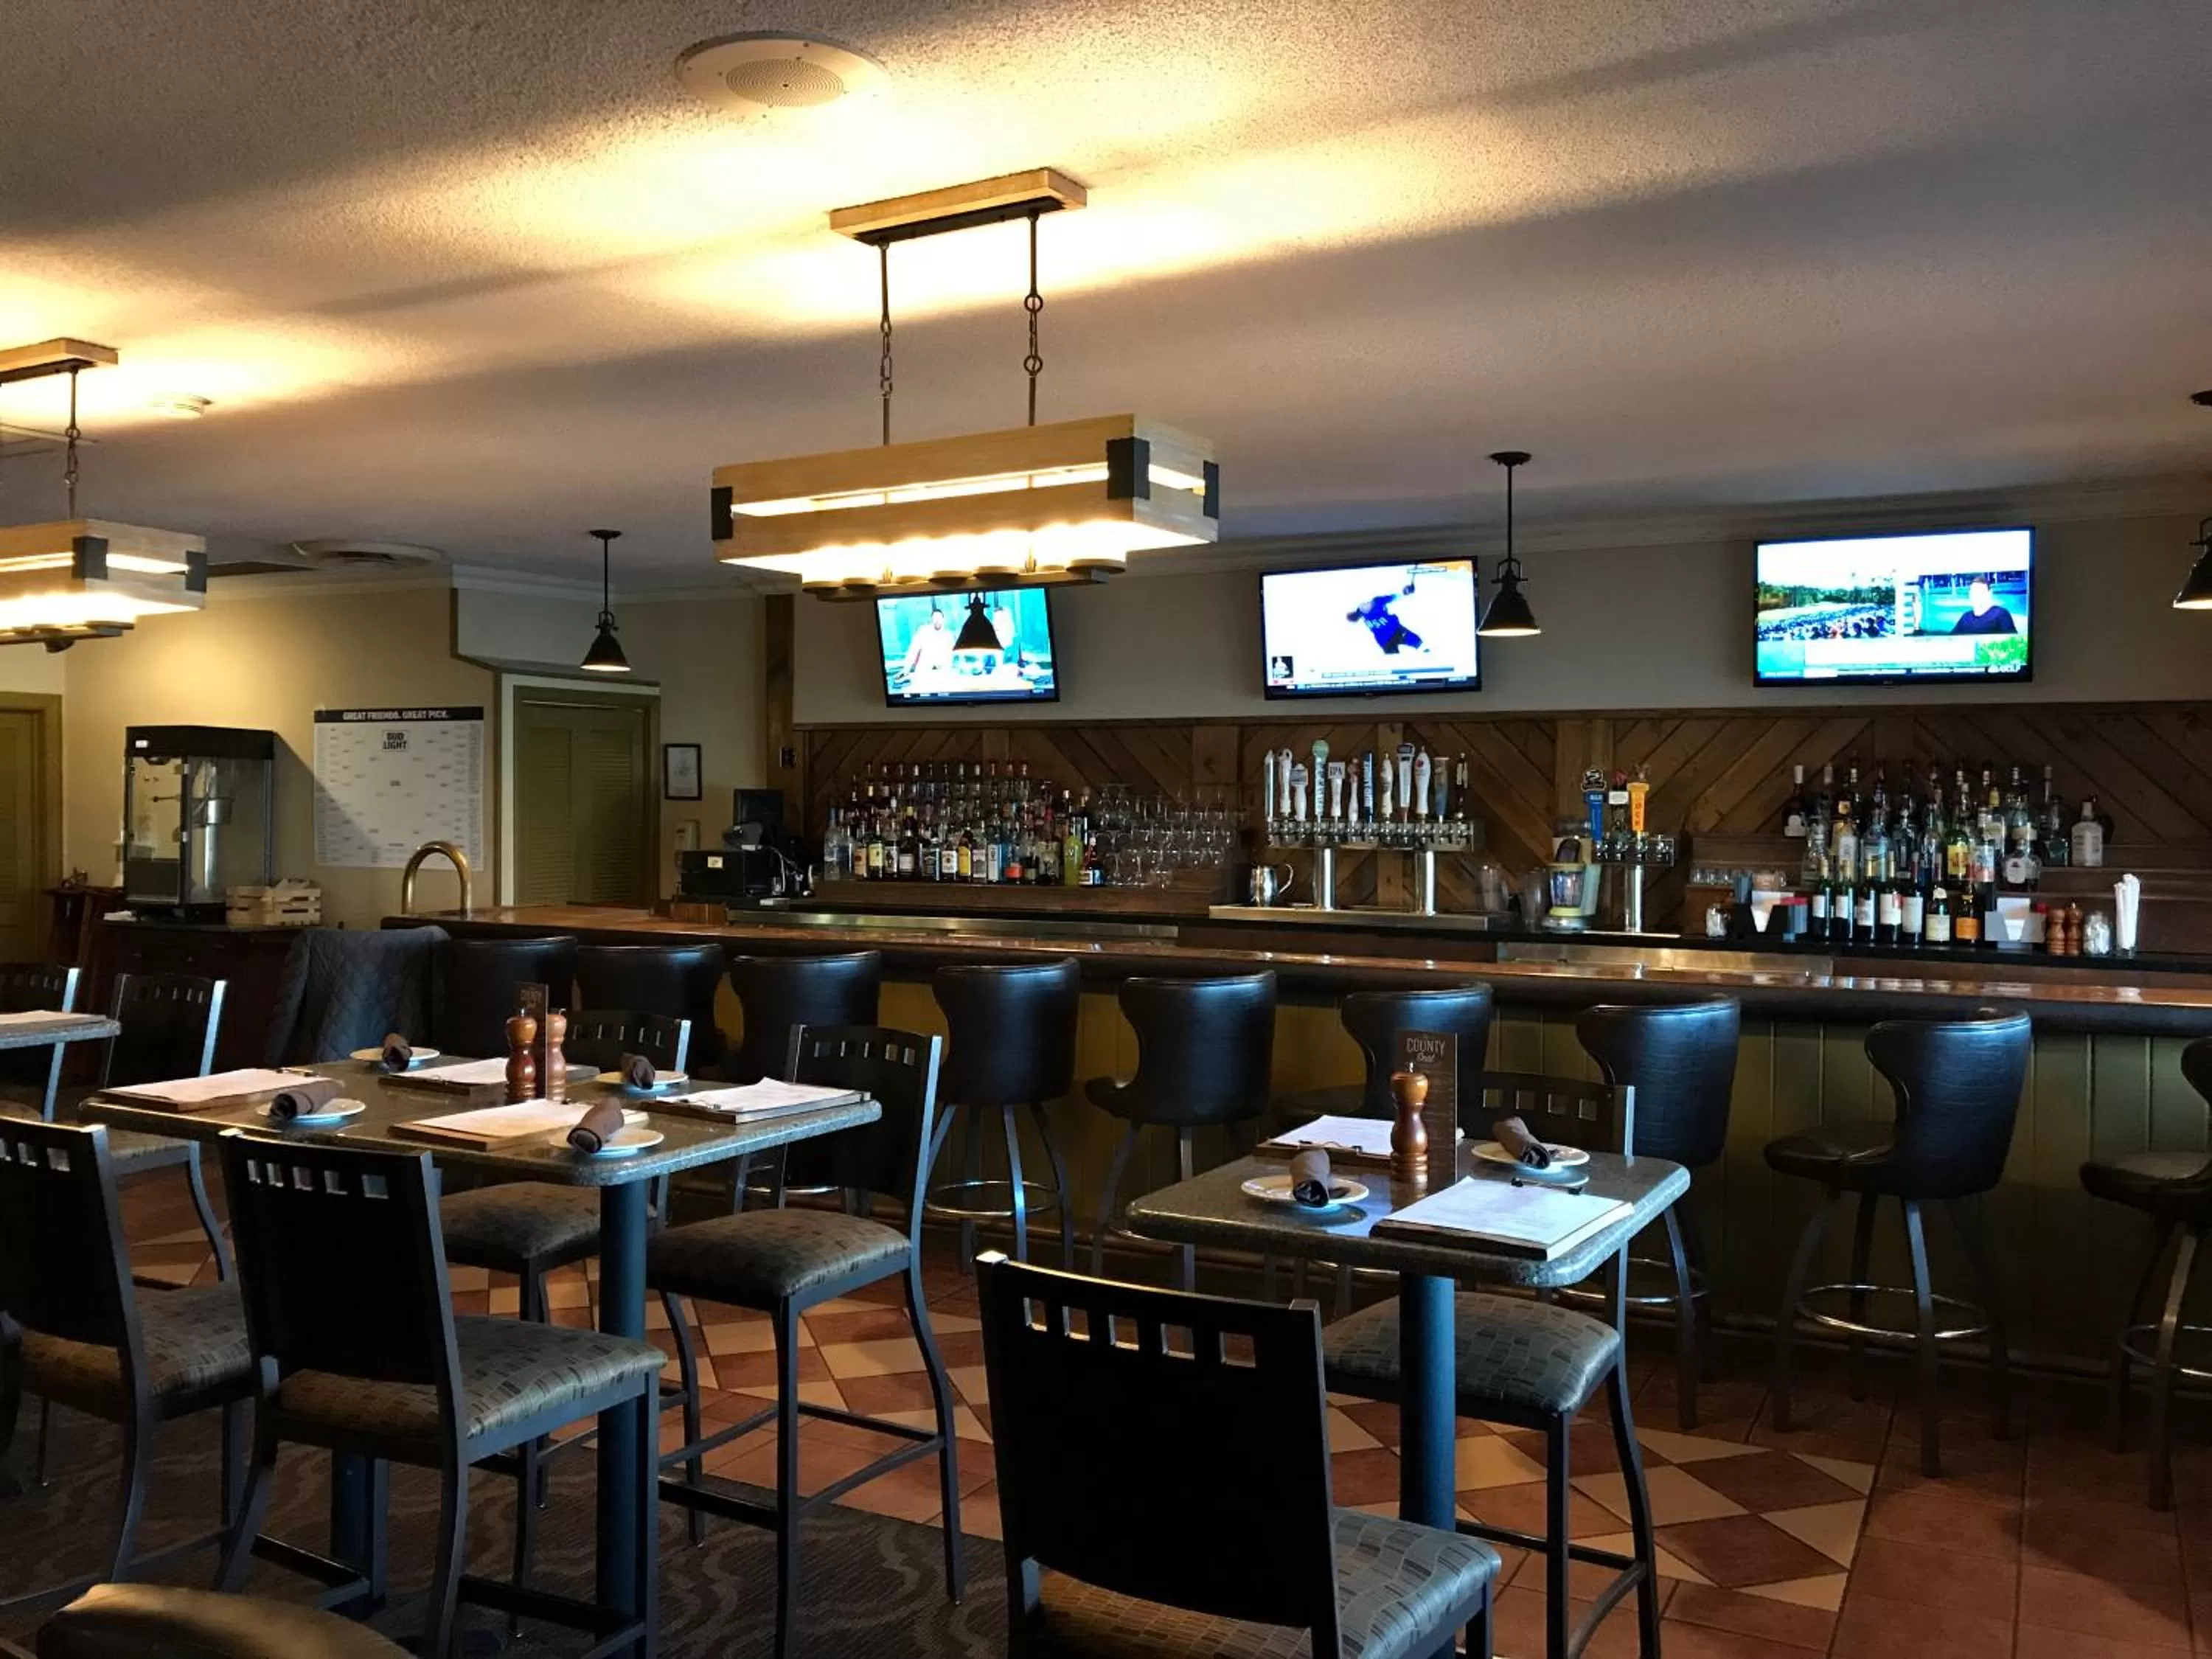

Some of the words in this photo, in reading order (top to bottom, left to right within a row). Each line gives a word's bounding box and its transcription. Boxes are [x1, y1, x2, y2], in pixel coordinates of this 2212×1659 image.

[386, 732, 405, 740] BUD
[383, 740, 407, 750] LIGHT
[1406, 1037, 1446, 1057] COUNTY
